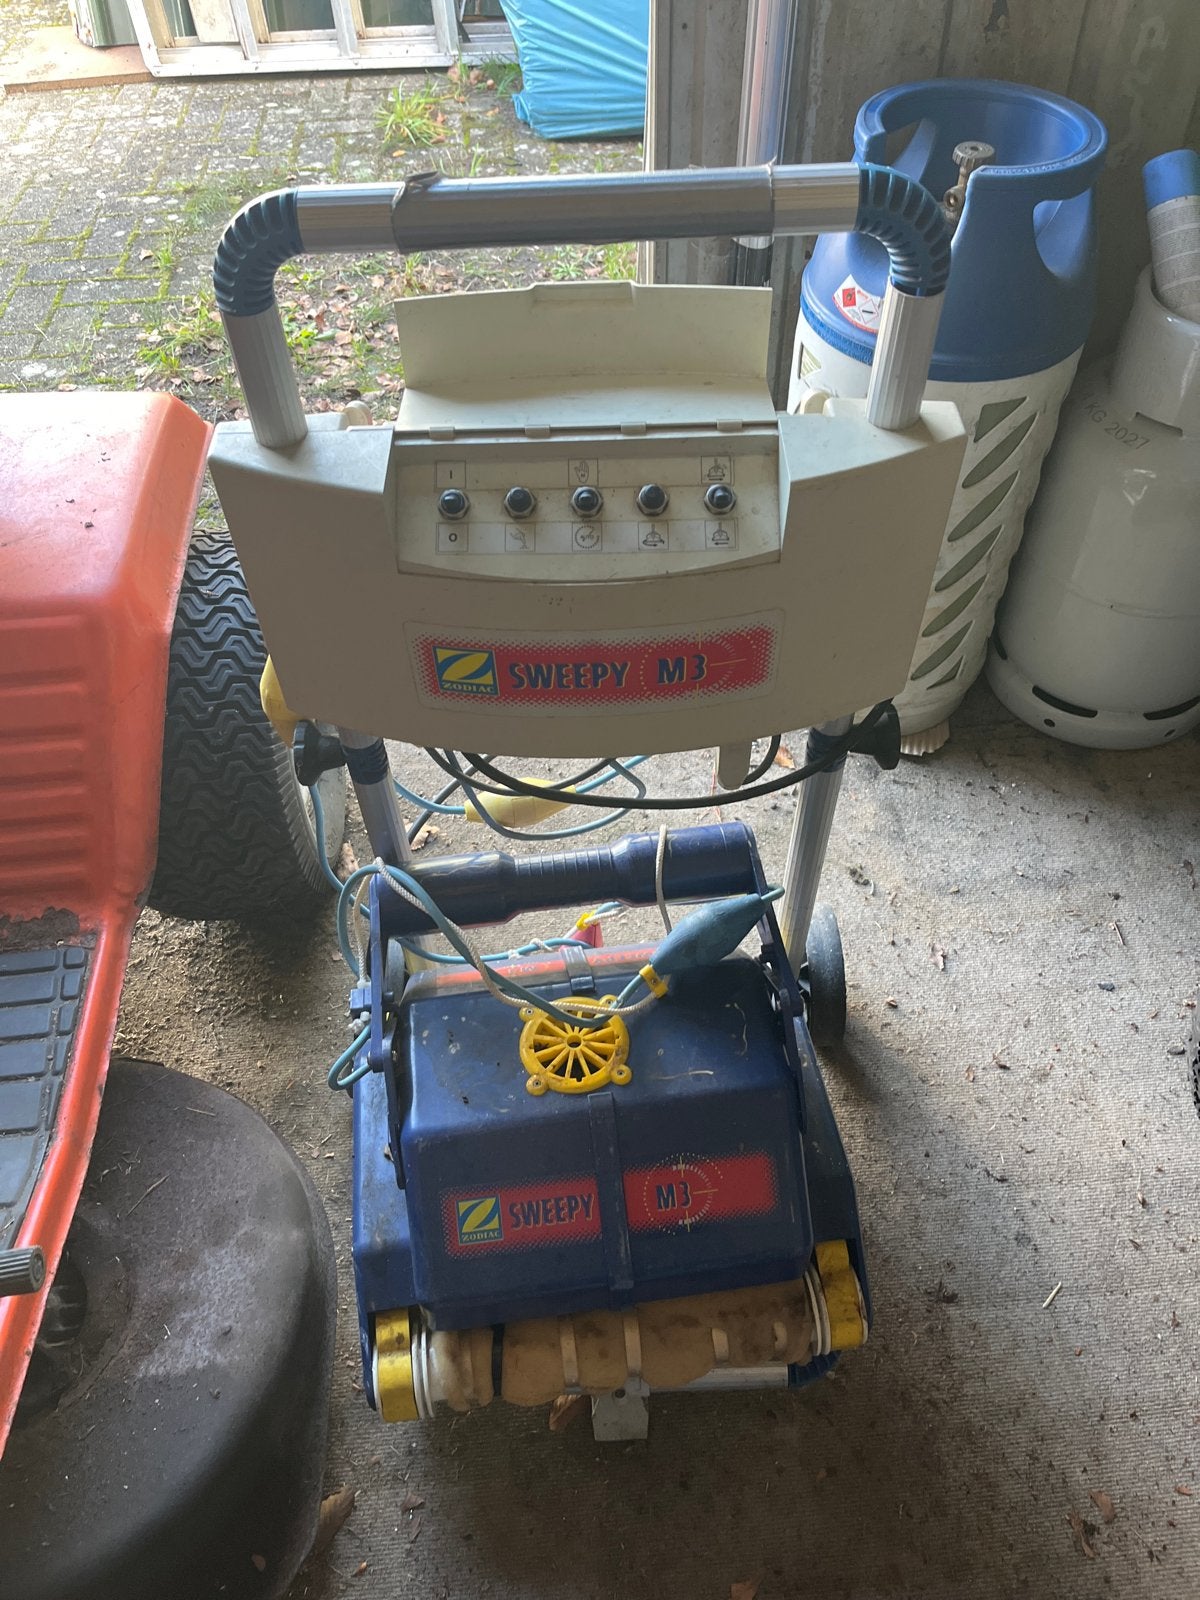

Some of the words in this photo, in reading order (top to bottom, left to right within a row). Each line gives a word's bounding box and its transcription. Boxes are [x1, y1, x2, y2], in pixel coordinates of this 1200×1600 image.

[1084, 401, 1107, 423] KG
[1103, 422, 1151, 449] 2027
[442, 682, 494, 693] ZODIAC
[508, 659, 631, 690] SWEEPY
[508, 1193, 595, 1230] SWEEPY
[462, 1230, 501, 1242] ZODIAC
